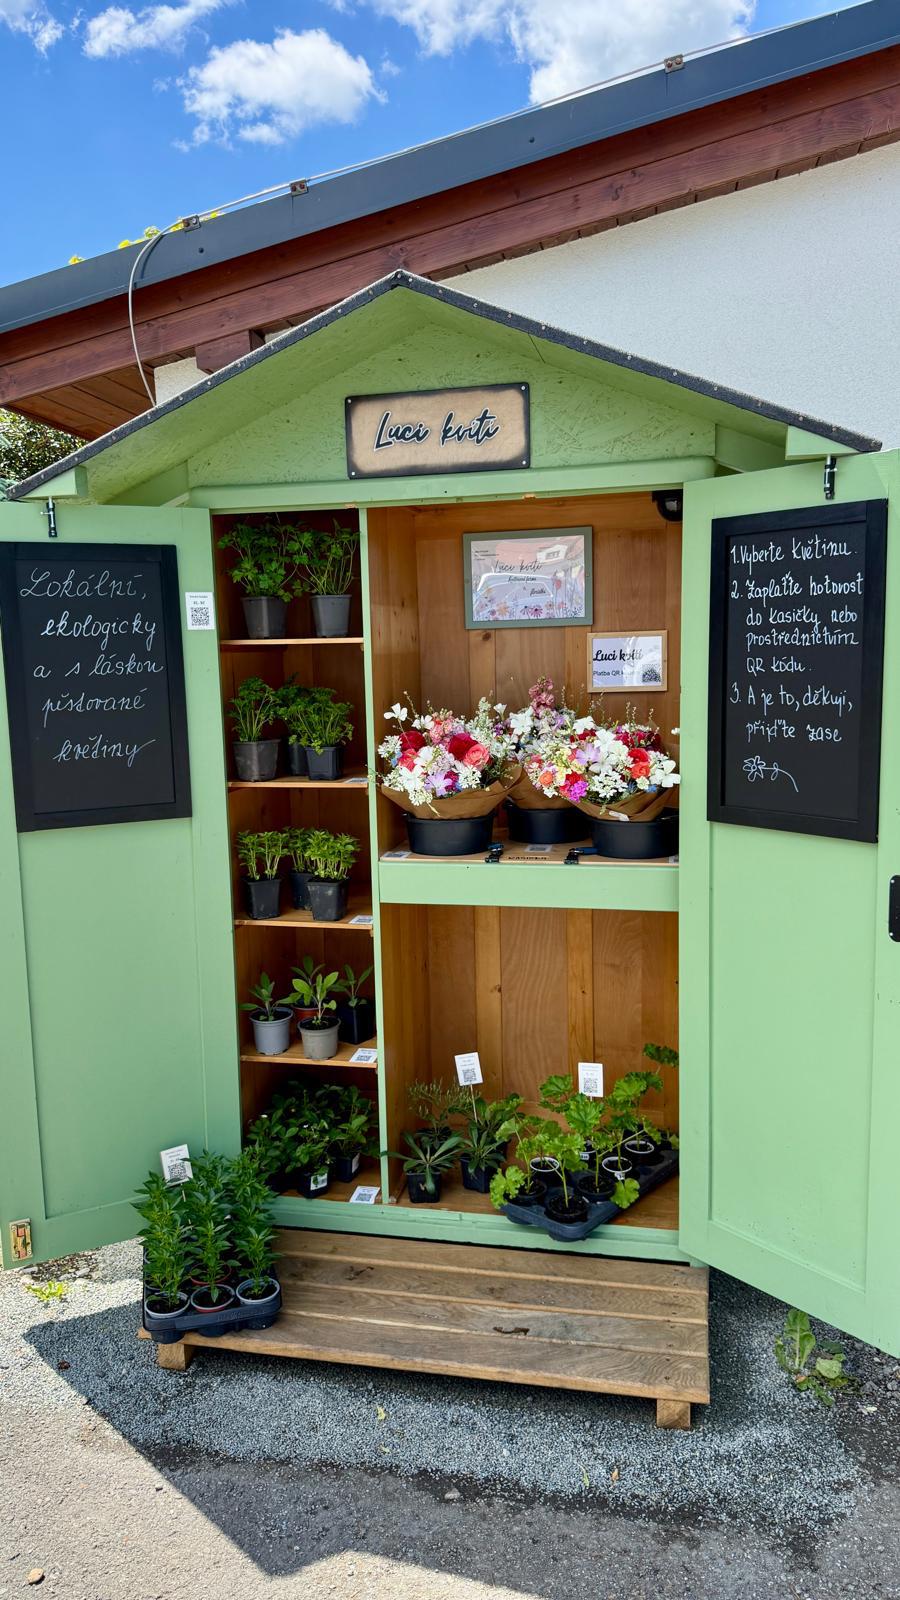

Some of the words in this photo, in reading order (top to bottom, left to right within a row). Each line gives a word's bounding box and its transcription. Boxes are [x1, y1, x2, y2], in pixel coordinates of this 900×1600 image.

[373, 410, 431, 452] Luci
[19, 567, 147, 600] Lokální,
[730, 579, 744, 599] 2.
[809, 572, 864, 597] hotovost
[745, 607, 763, 626] do
[830, 604, 858, 623] nebo
[40, 610, 156, 652] ekologicky
[745, 626, 860, 652] prostřednictvím
[33, 665, 52, 678] a
[64, 662, 81, 677] s
[88, 652, 164, 677] láskou
[592, 649, 618, 662] Luci
[746, 657, 766, 677] QR
[42, 687, 148, 729] pěstované
[729, 681, 742, 704] 3.
[747, 684, 756, 705] A
[760, 688, 775, 716] je
[779, 684, 800, 712] to,
[802, 684, 853, 718] děkuji,
[806, 724, 843, 742] zase
[52, 733, 156, 768] květiny
